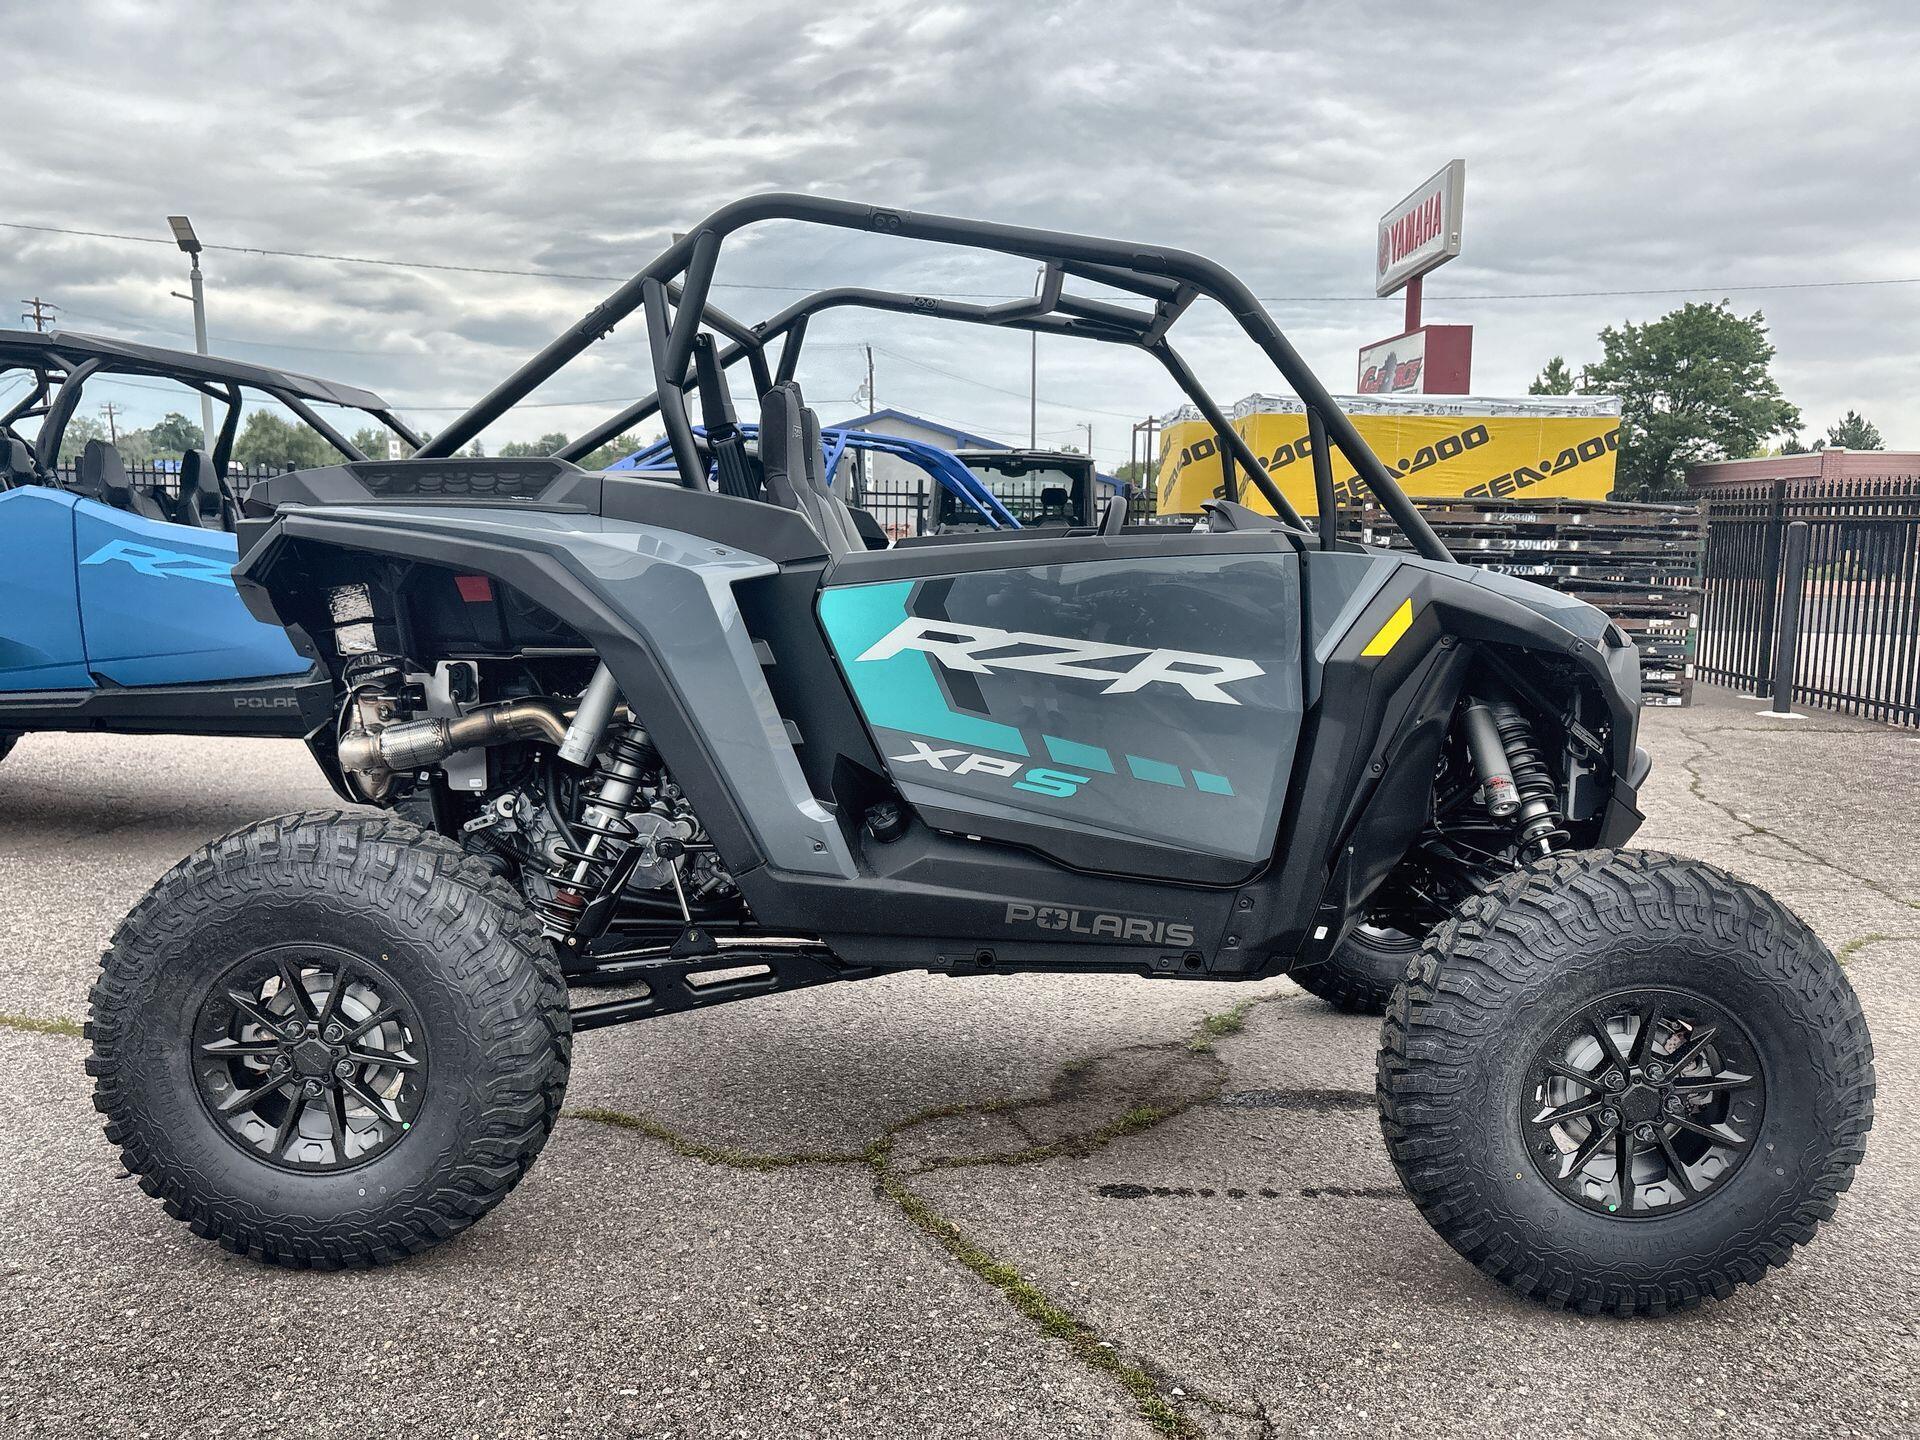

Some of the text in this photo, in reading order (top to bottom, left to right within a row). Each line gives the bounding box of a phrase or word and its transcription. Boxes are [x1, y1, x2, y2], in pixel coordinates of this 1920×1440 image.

[1391, 191, 1441, 264] YAMAHA
[80, 539, 236, 588] RZ
[854, 616, 1266, 706] RZR
[233, 697, 300, 708] POLAR
[1005, 904, 1195, 947] POLARIS
